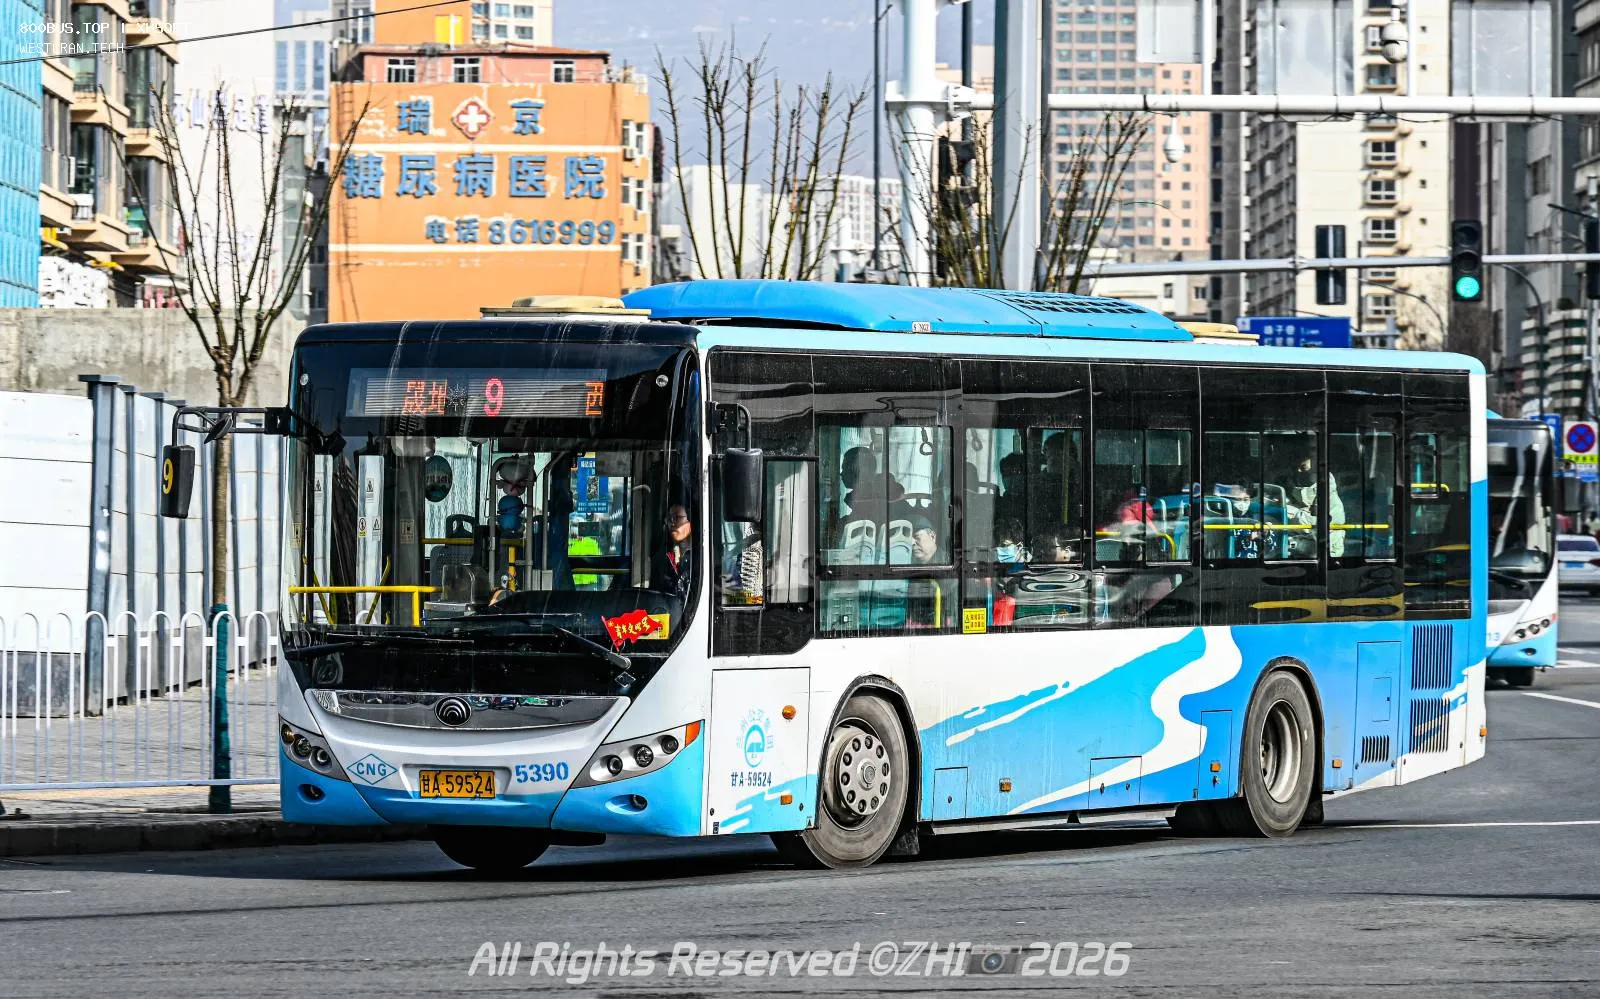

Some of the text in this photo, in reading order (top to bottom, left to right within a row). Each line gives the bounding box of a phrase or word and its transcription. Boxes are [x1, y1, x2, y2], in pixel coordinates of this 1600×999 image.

[397, 100, 545, 135] 瑞 京
[343, 153, 606, 199] 糖尿病医院
[425, 218, 616, 245] 电话 8616999
[483, 378, 505, 417] 9
[162, 458, 173, 494] 9
[356, 762, 387, 777] CNG
[515, 761, 569, 784] 5390
